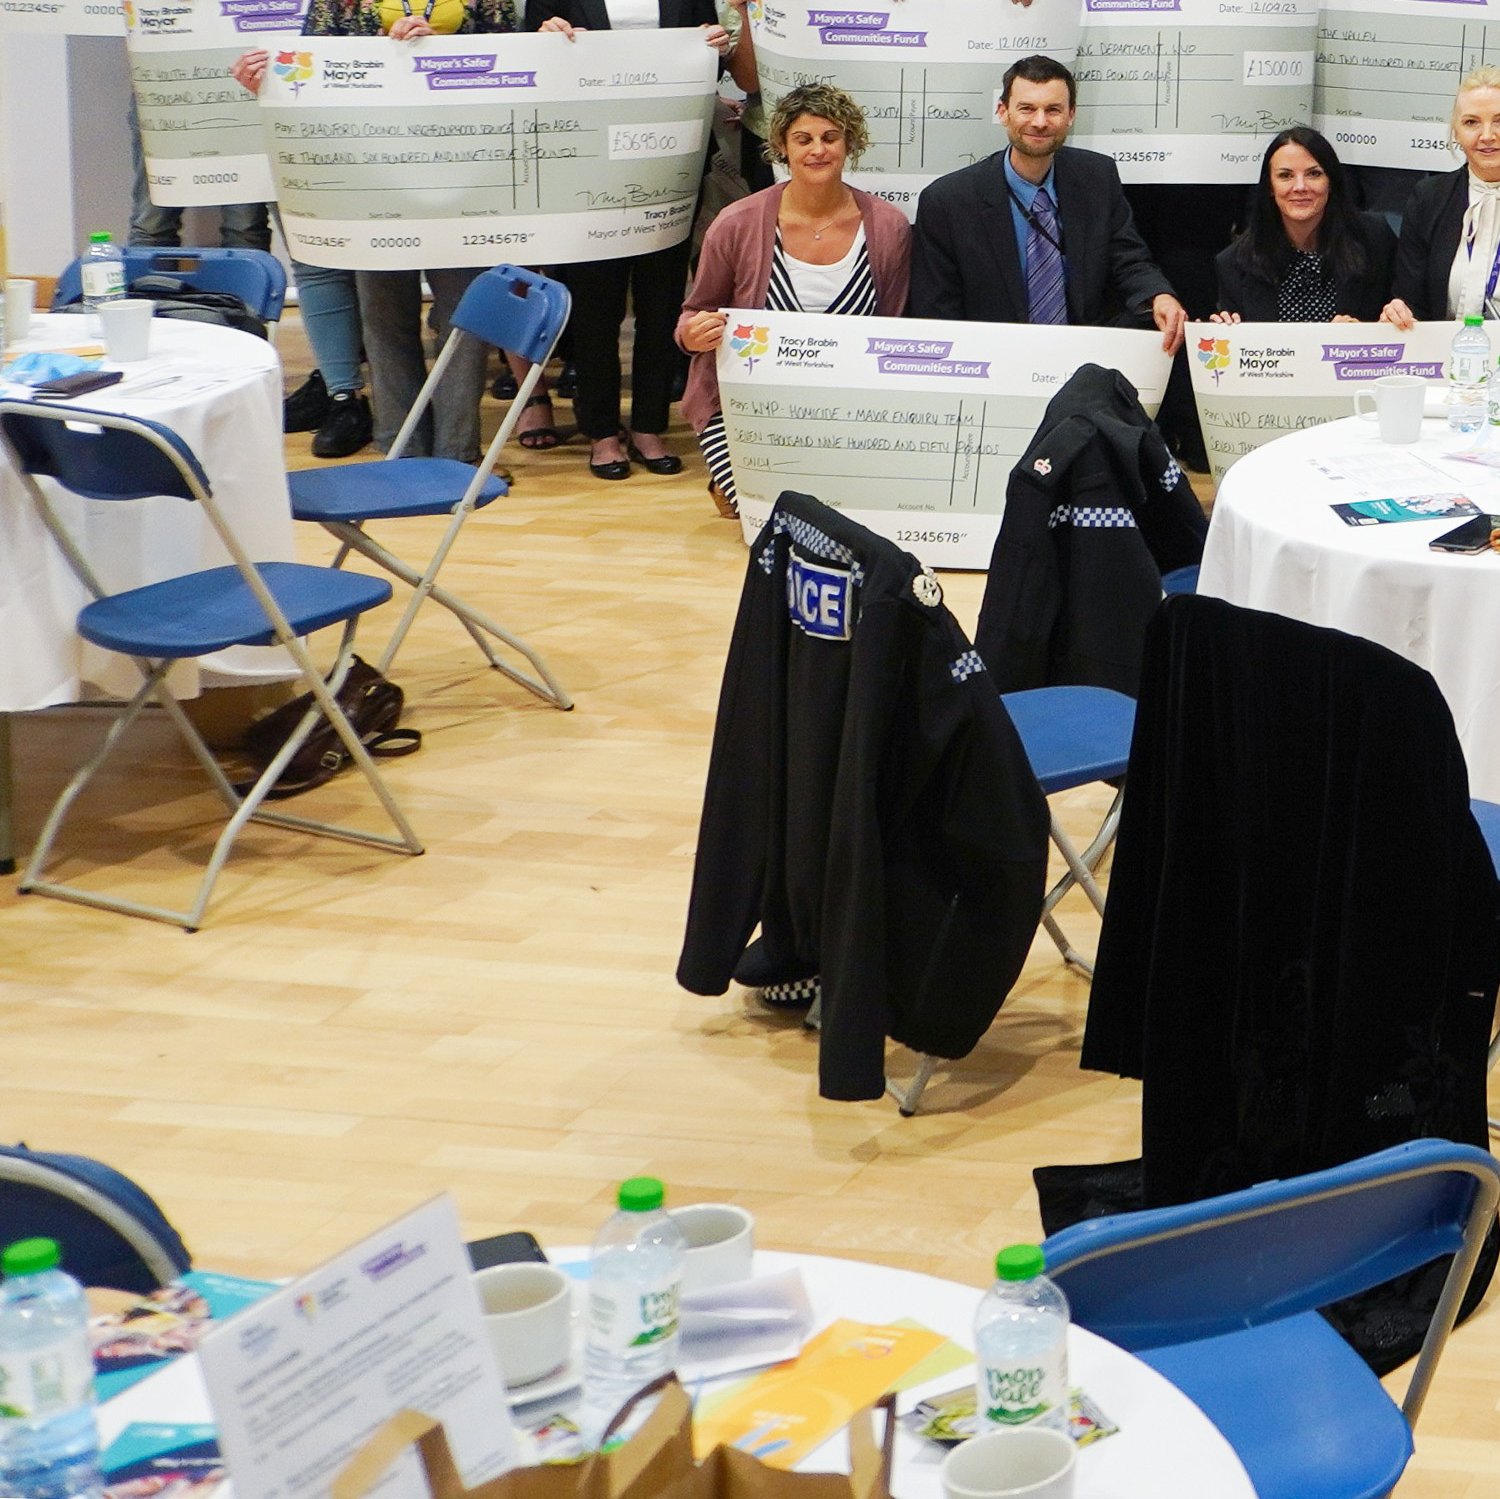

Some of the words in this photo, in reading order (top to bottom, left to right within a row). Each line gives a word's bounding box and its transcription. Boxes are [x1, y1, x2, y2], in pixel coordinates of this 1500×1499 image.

[1090, 0, 1153, 10] Communities
[814, 14, 853, 28] Mayor's
[854, 14, 883, 26] Safer
[824, 31, 891, 45] Communities
[893, 32, 920, 45] Fund
[462, 56, 492, 70] Safer
[323, 69, 368, 83] Mayor
[432, 73, 496, 88] Communities
[498, 72, 529, 86] Fund
[777, 345, 821, 361] Mayor
[873, 340, 915, 355] Mayor's
[916, 342, 946, 355] Safer
[1328, 346, 1369, 361] Mayor's
[1371, 345, 1398, 357] Safer
[883, 358, 952, 375] Communities
[954, 362, 982, 376] Fund
[1239, 356, 1279, 370] Mayor
[1340, 364, 1407, 378] Communities
[1409, 364, 1436, 376] Fund
